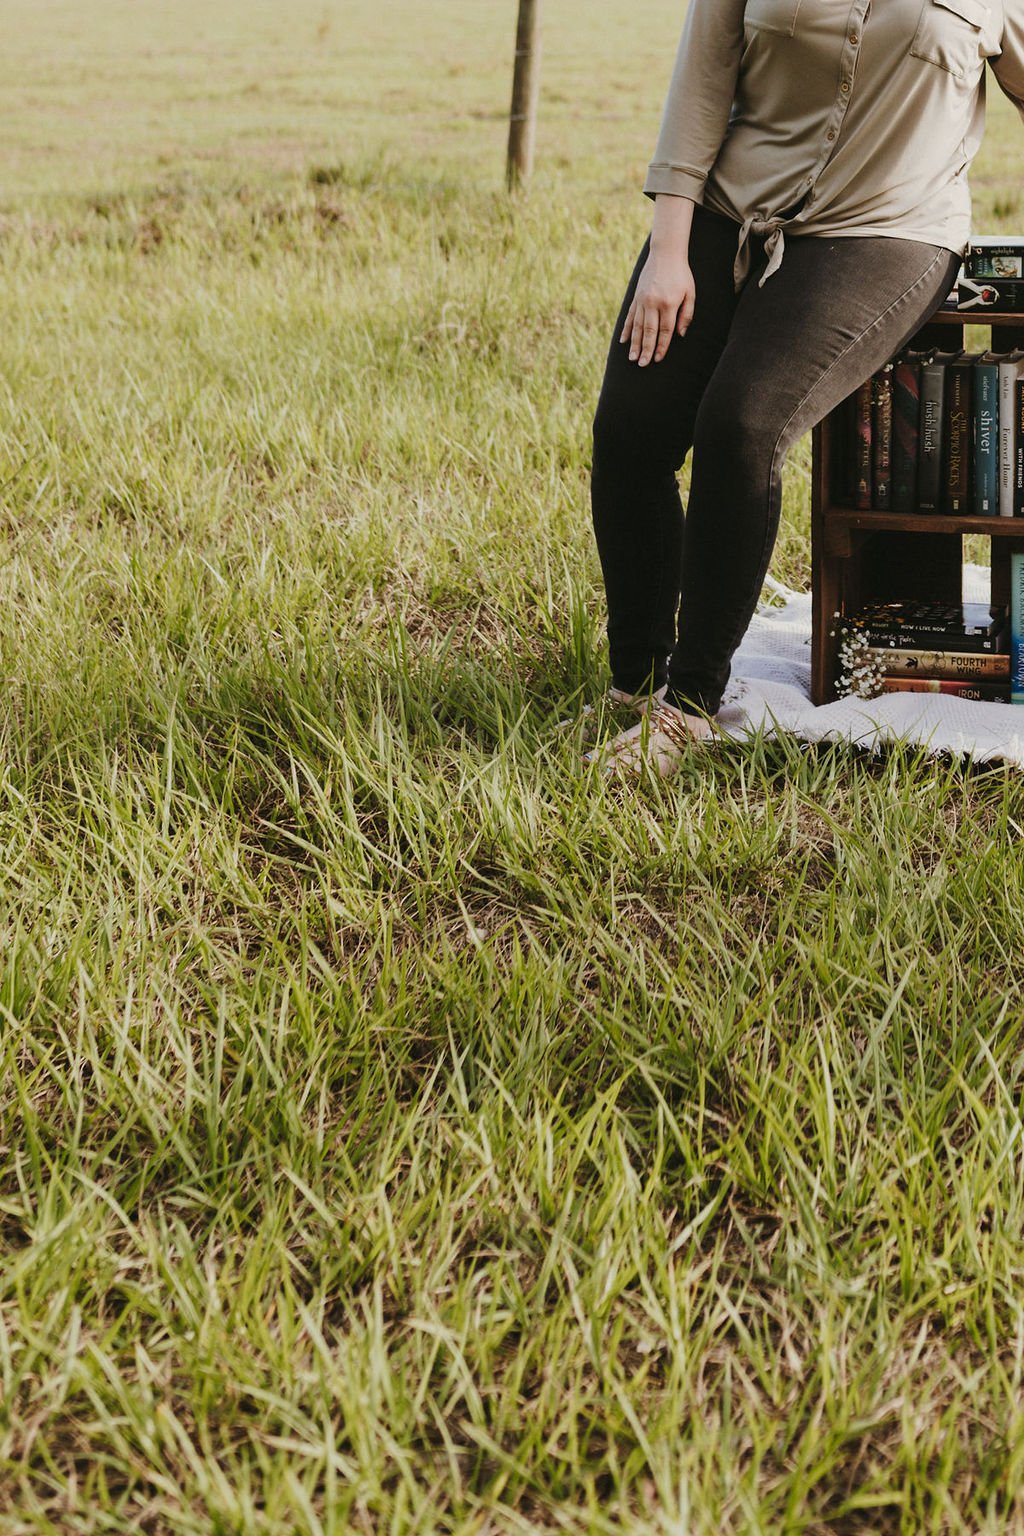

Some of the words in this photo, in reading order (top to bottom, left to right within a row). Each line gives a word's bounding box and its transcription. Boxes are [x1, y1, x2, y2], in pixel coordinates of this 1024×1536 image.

[951, 411, 965, 453] SCORPIO
[980, 410, 993, 455] shiver
[1002, 427, 1011, 460] Forever
[949, 455, 962, 486] RACES
[1002, 463, 1011, 489] Home
[951, 656, 987, 666] FOURTH
[957, 666, 981, 674] WING
[958, 689, 980, 699] IRON
